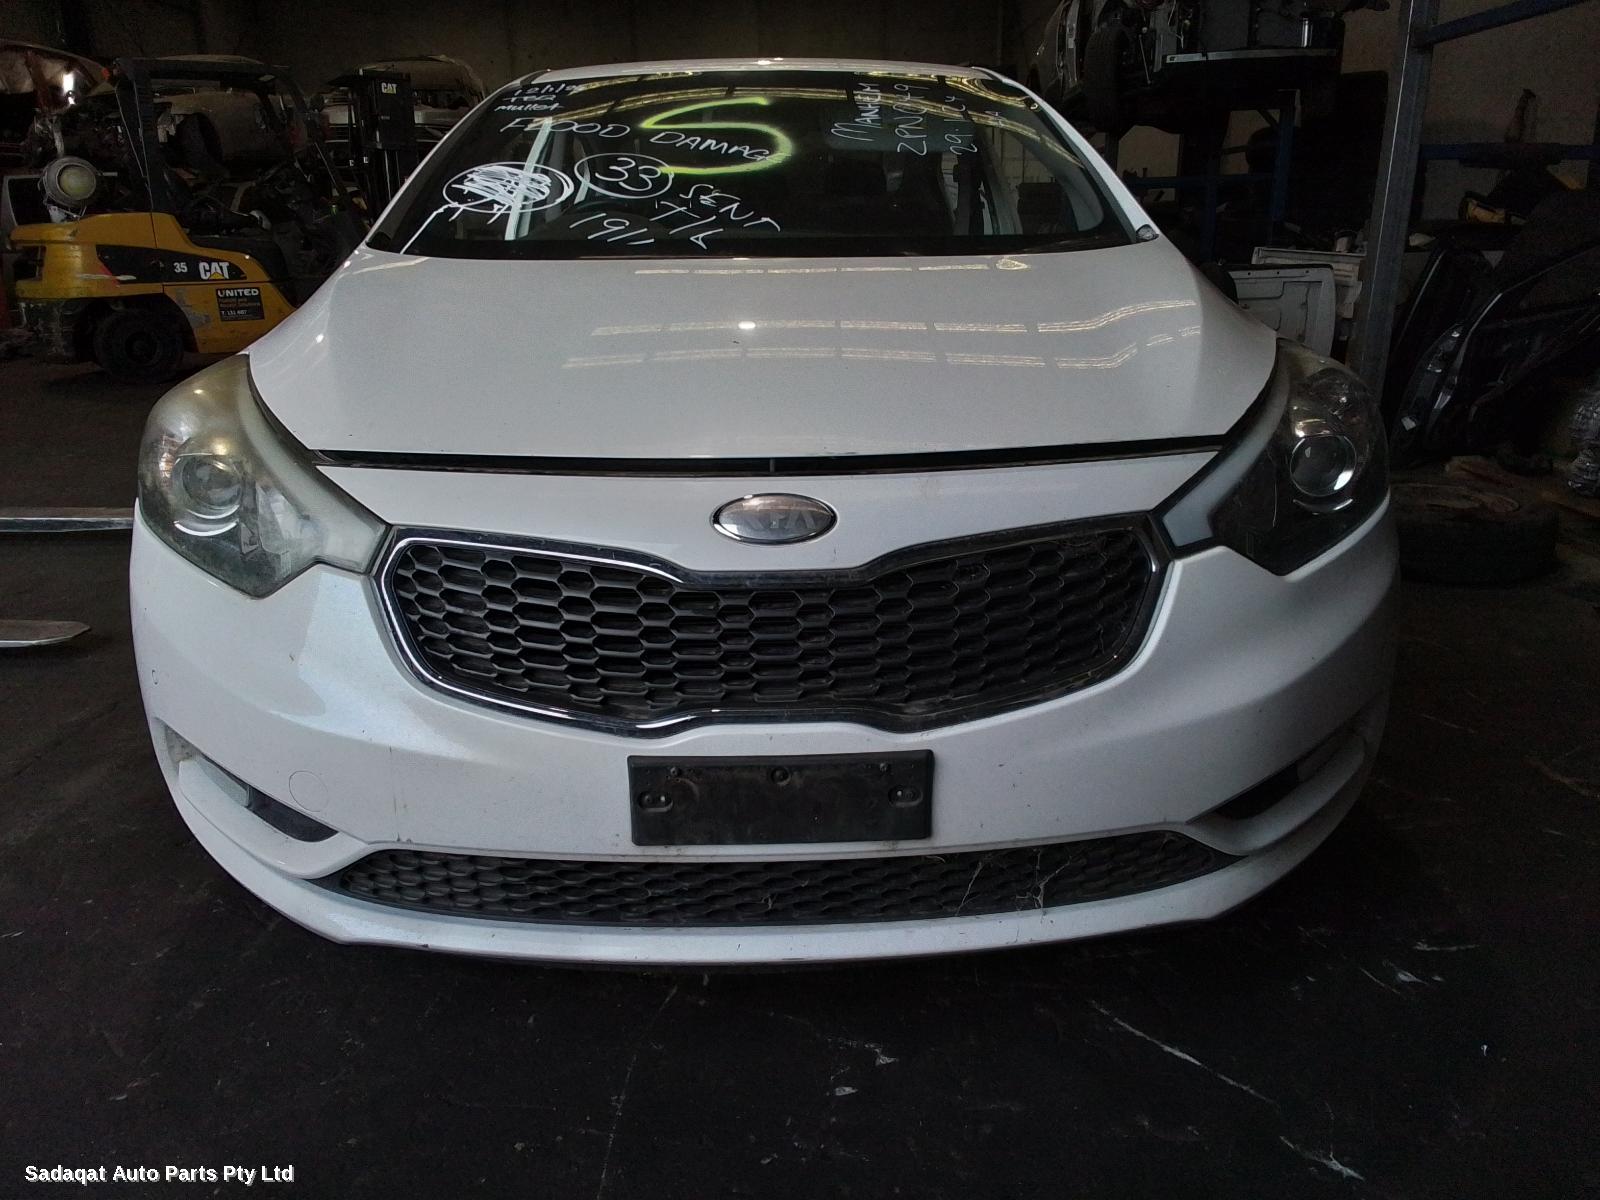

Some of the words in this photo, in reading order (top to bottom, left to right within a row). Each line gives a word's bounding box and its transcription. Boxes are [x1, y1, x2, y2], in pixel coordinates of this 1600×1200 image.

[380, 81, 398, 95] CAT
[595, 157, 661, 191] 33
[173, 262, 188, 273] 35
[198, 261, 230, 281] CAT
[217, 288, 259, 298] UNITED
